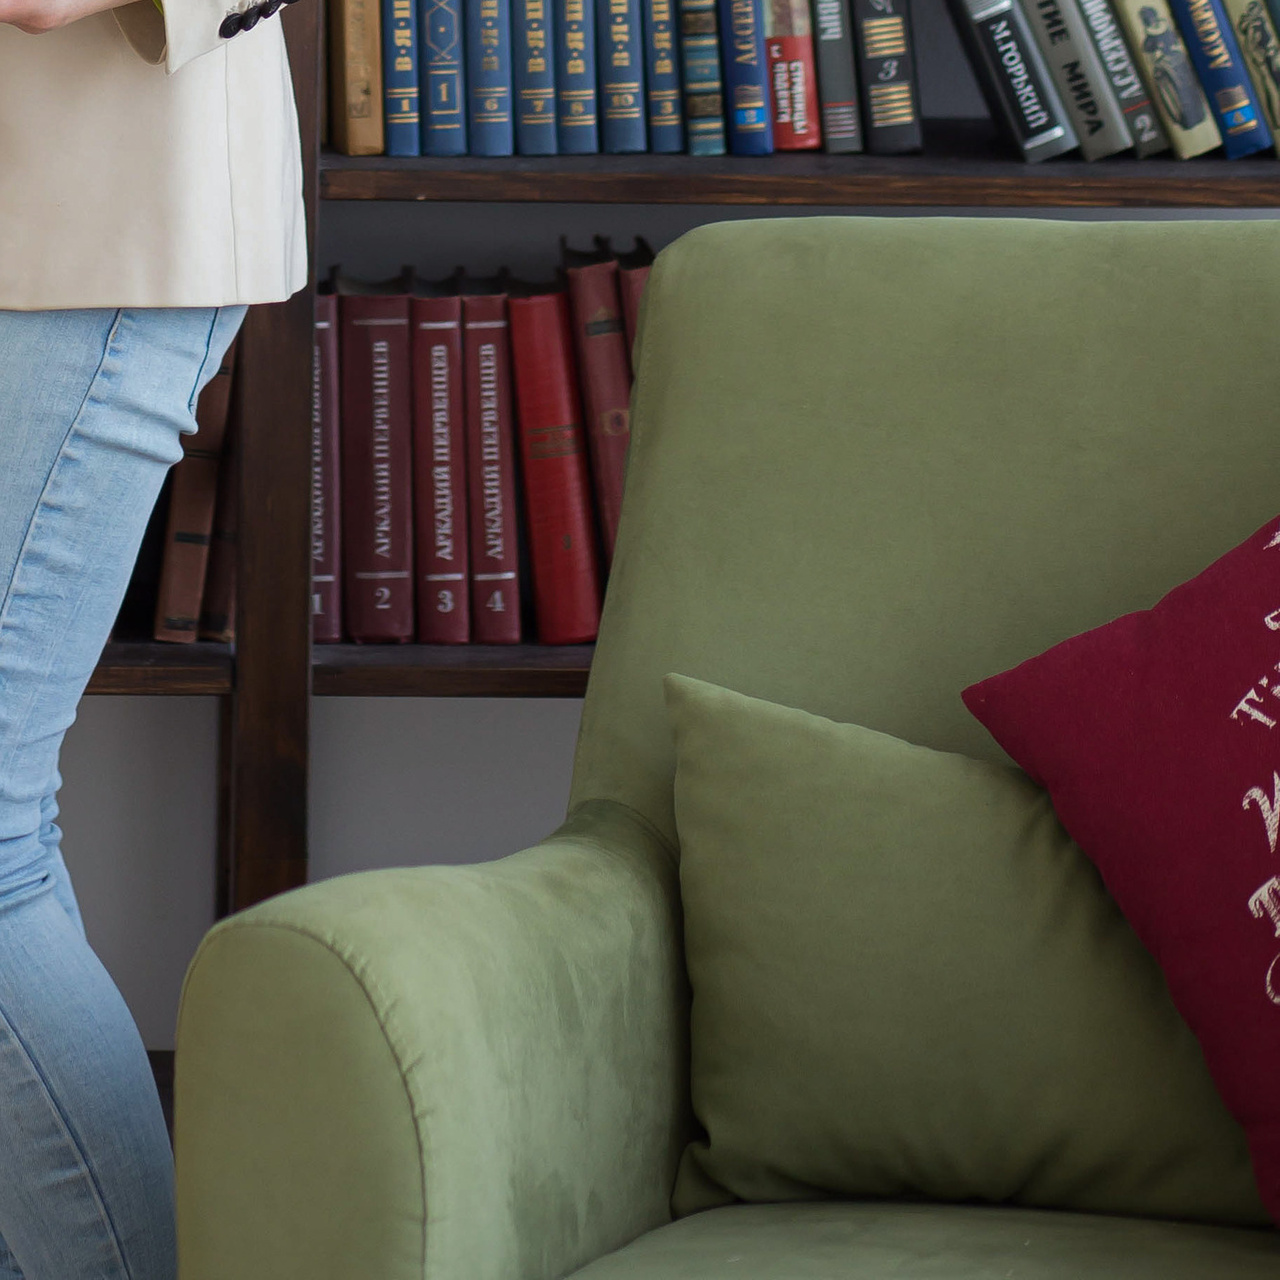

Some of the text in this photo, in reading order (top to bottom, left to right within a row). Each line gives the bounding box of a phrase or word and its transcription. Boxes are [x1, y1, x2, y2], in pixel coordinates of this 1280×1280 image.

[1062, 60, 1106, 137] МИРА
[374, 586, 391, 610] 2
[436, 590, 454, 613] 3
[486, 589, 505, 612] 4
